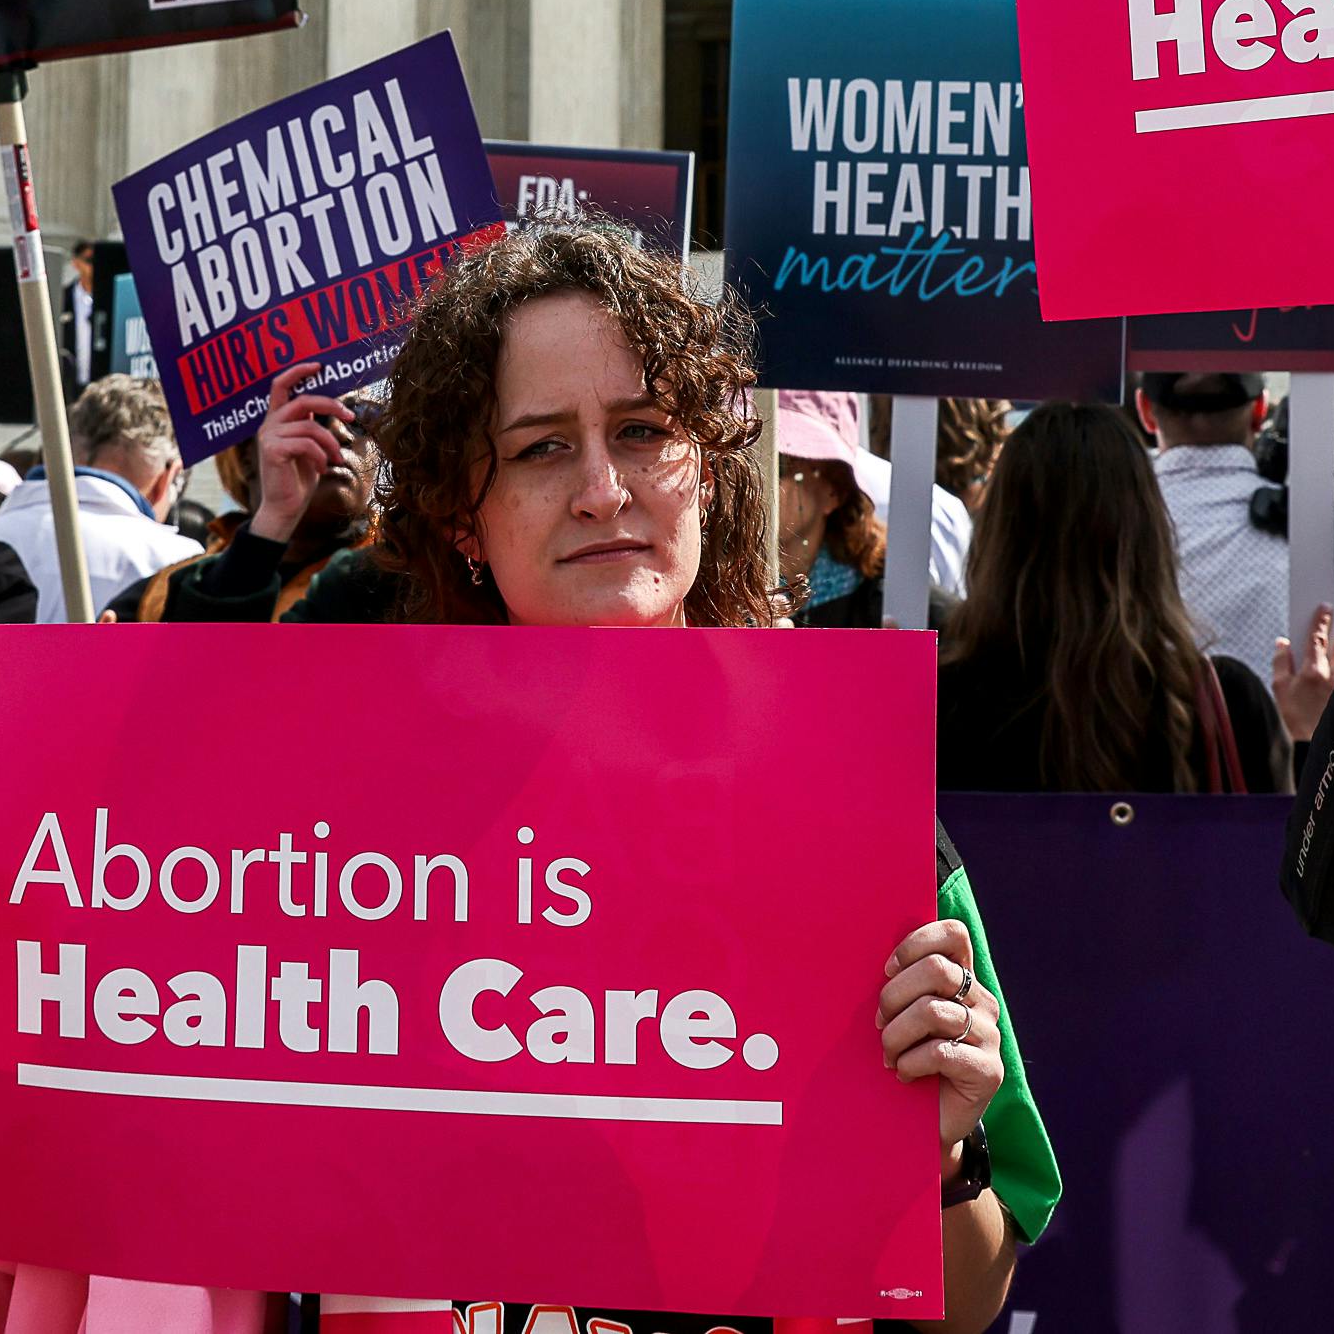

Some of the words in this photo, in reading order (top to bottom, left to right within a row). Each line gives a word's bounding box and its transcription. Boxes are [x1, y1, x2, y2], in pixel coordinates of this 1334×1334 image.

[147, 77, 435, 265] CHEMICAL
[813, 160, 1032, 241] HEALTH
[171, 152, 458, 347] ABORTION
[774, 225, 1039, 301] matter
[187, 308, 296, 408] HURTS
[301, 243, 456, 351] WOME
[8, 807, 469, 924] Abortion
[516, 826, 593, 928] is
[1296, 810, 1316, 878] under
[17, 940, 399, 1056] Health
[439, 957, 780, 1071] Care.
